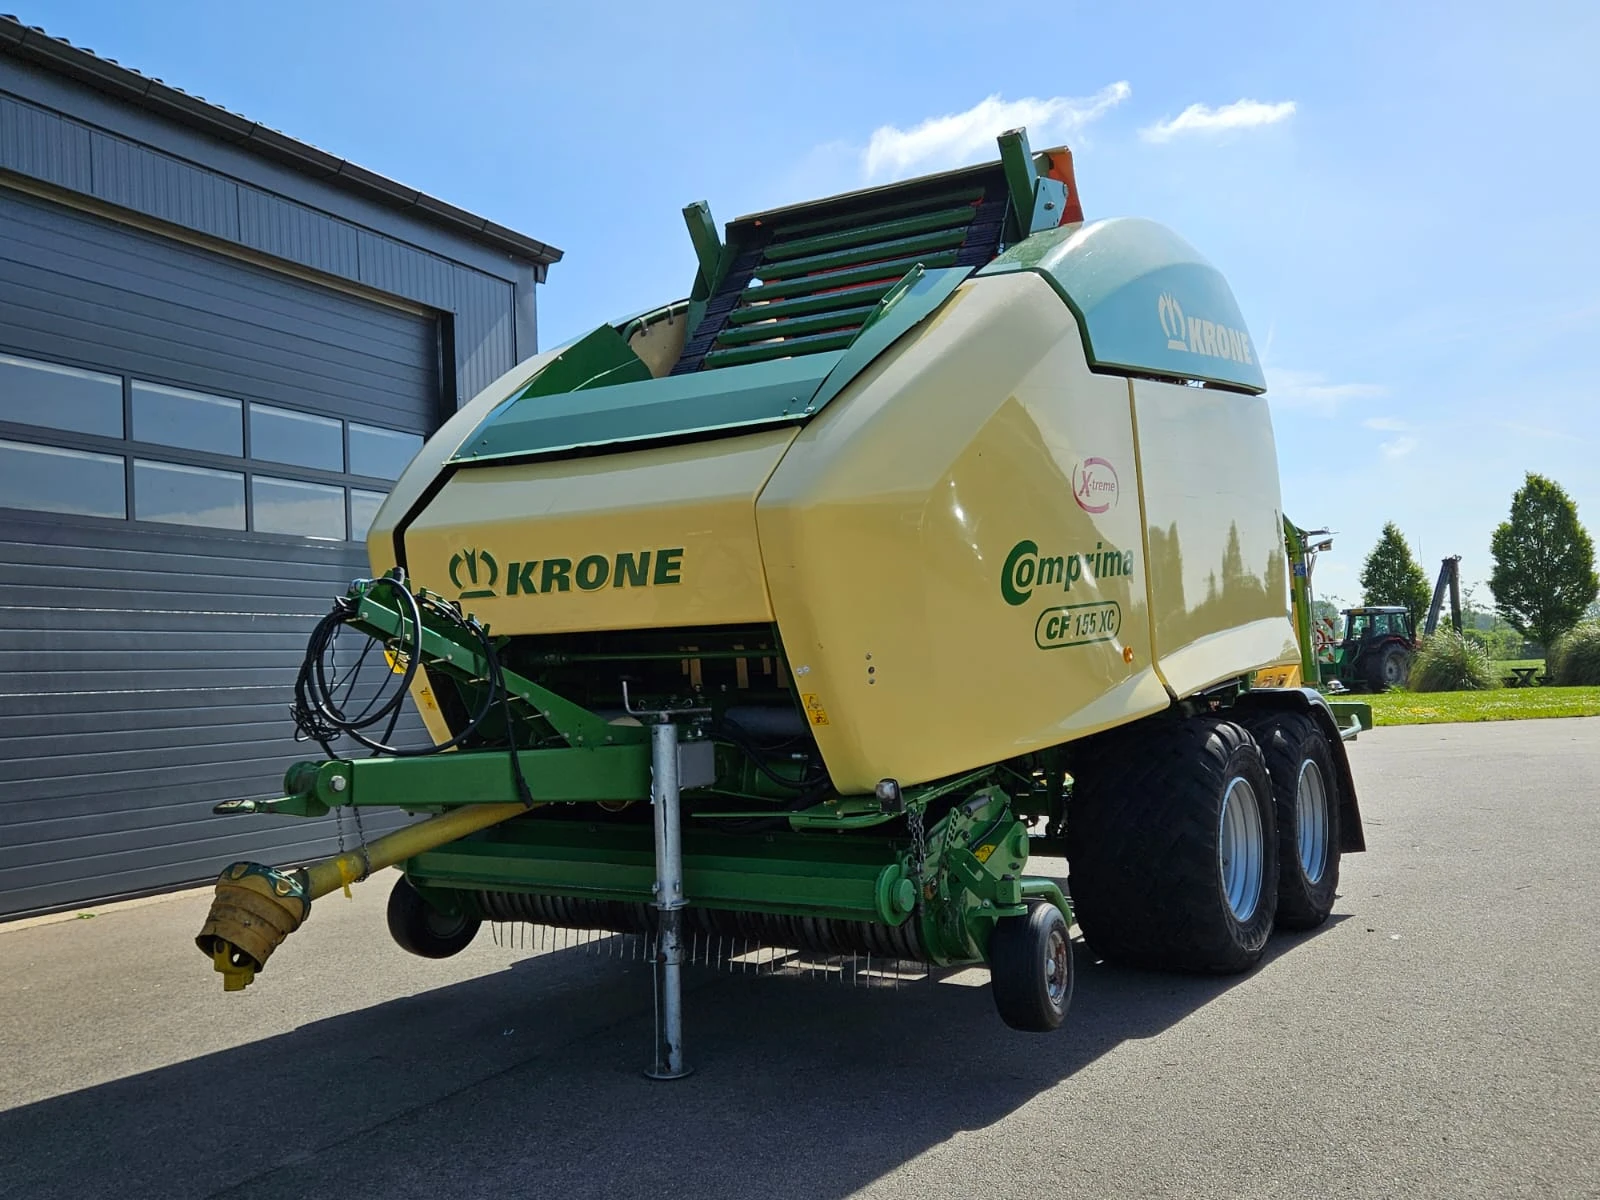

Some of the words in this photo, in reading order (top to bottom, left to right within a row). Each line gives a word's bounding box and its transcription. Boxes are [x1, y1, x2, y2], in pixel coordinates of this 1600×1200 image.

[1187, 316, 1253, 365] KRONE
[1078, 470, 1116, 497] X-treme
[506, 548, 684, 596] KRONE
[1001, 539, 1135, 606] Comprima
[1046, 614, 1072, 640] CF
[1075, 611, 1097, 637] 155
[1099, 608, 1116, 633] XC
